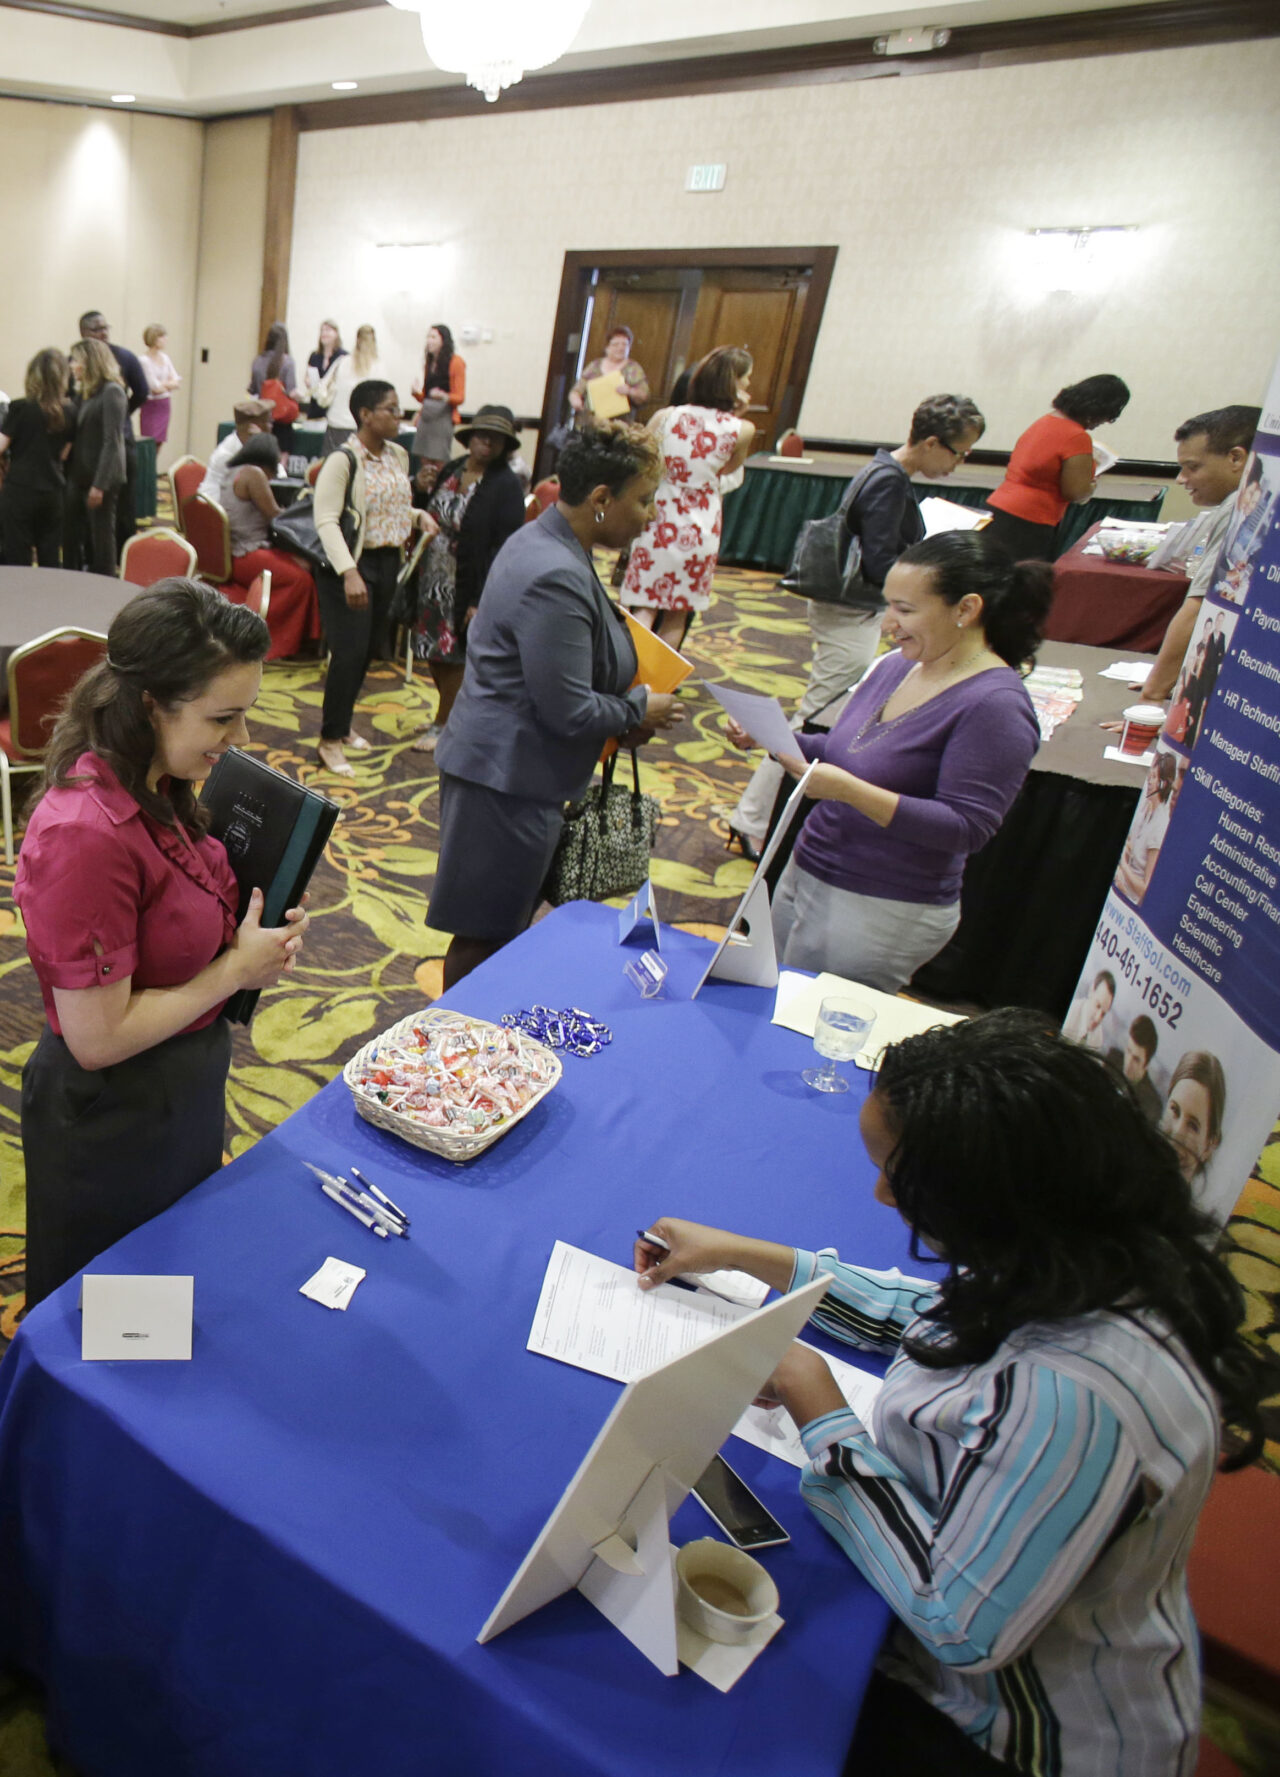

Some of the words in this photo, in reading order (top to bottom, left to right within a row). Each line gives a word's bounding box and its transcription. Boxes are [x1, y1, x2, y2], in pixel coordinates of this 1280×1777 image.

[691, 165, 722, 188] EXIT
[1223, 690, 1240, 710] HR
[1239, 698, 1280, 738] Technolo
[1210, 730, 1251, 765] Managed
[1194, 766, 1213, 789] Skill
[1211, 780, 1265, 824] Categories:
[1218, 811, 1254, 845] Human
[1209, 833, 1277, 889] Administrative
[1187, 893, 1243, 949] Engineering
[1195, 874, 1216, 897] Call
[1214, 889, 1249, 922] Center
[1172, 933, 1222, 984] Healthcare
[1179, 914, 1223, 957] Scientific
